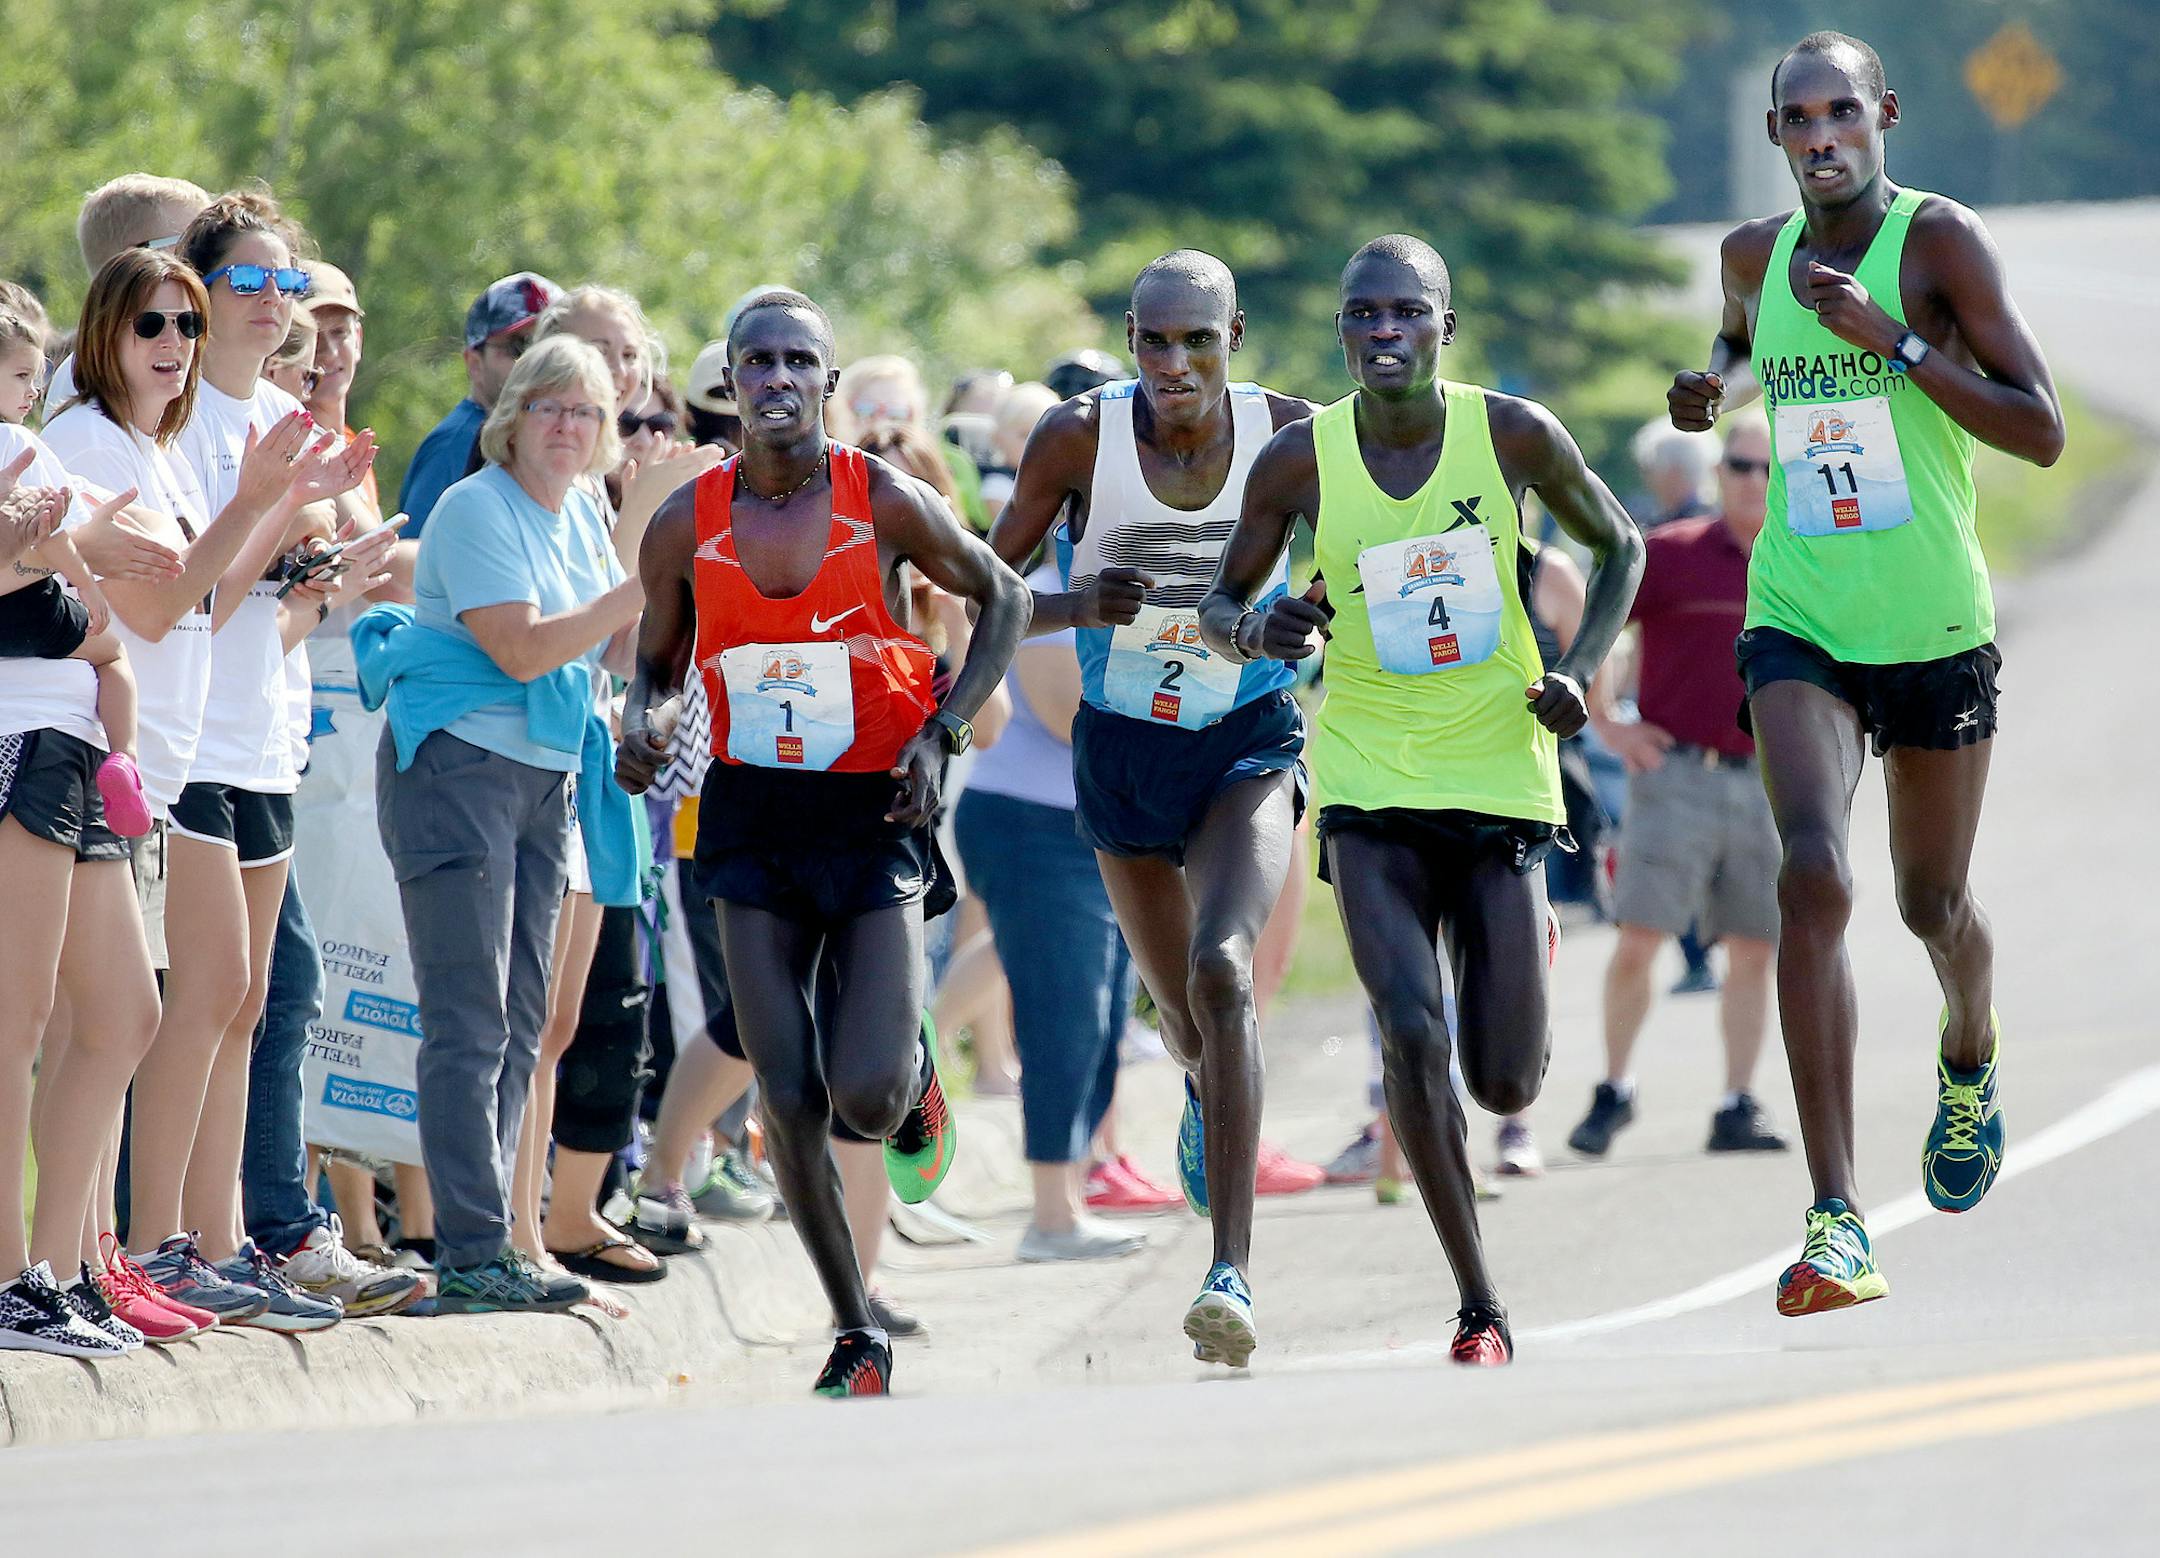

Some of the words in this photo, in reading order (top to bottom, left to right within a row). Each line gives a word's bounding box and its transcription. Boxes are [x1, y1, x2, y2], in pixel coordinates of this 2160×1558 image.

[1762, 351, 1894, 381] MARATHO
[1817, 462, 1858, 495] 11
[1834, 506, 1858, 514] WELLS
[1836, 513, 1860, 521] FARGO
[1428, 596, 1451, 630] 4
[1431, 641, 1457, 651] WELLS
[1433, 648, 1458, 658] FARGO
[1160, 660, 1184, 692] 2
[1153, 706, 1177, 715] FARGO
[1154, 699, 1178, 709] WELLS
[779, 701, 793, 732] 1
[777, 742, 802, 750] WELLS
[778, 749, 802, 757] FARGO
[323, 941, 391, 967] FARGO
[352, 1004, 410, 1029] TOYOTA
[310, 1025, 366, 1050] FARG
[310, 1043, 361, 1068] WELL
[330, 1087, 383, 1110] TOYOTA
